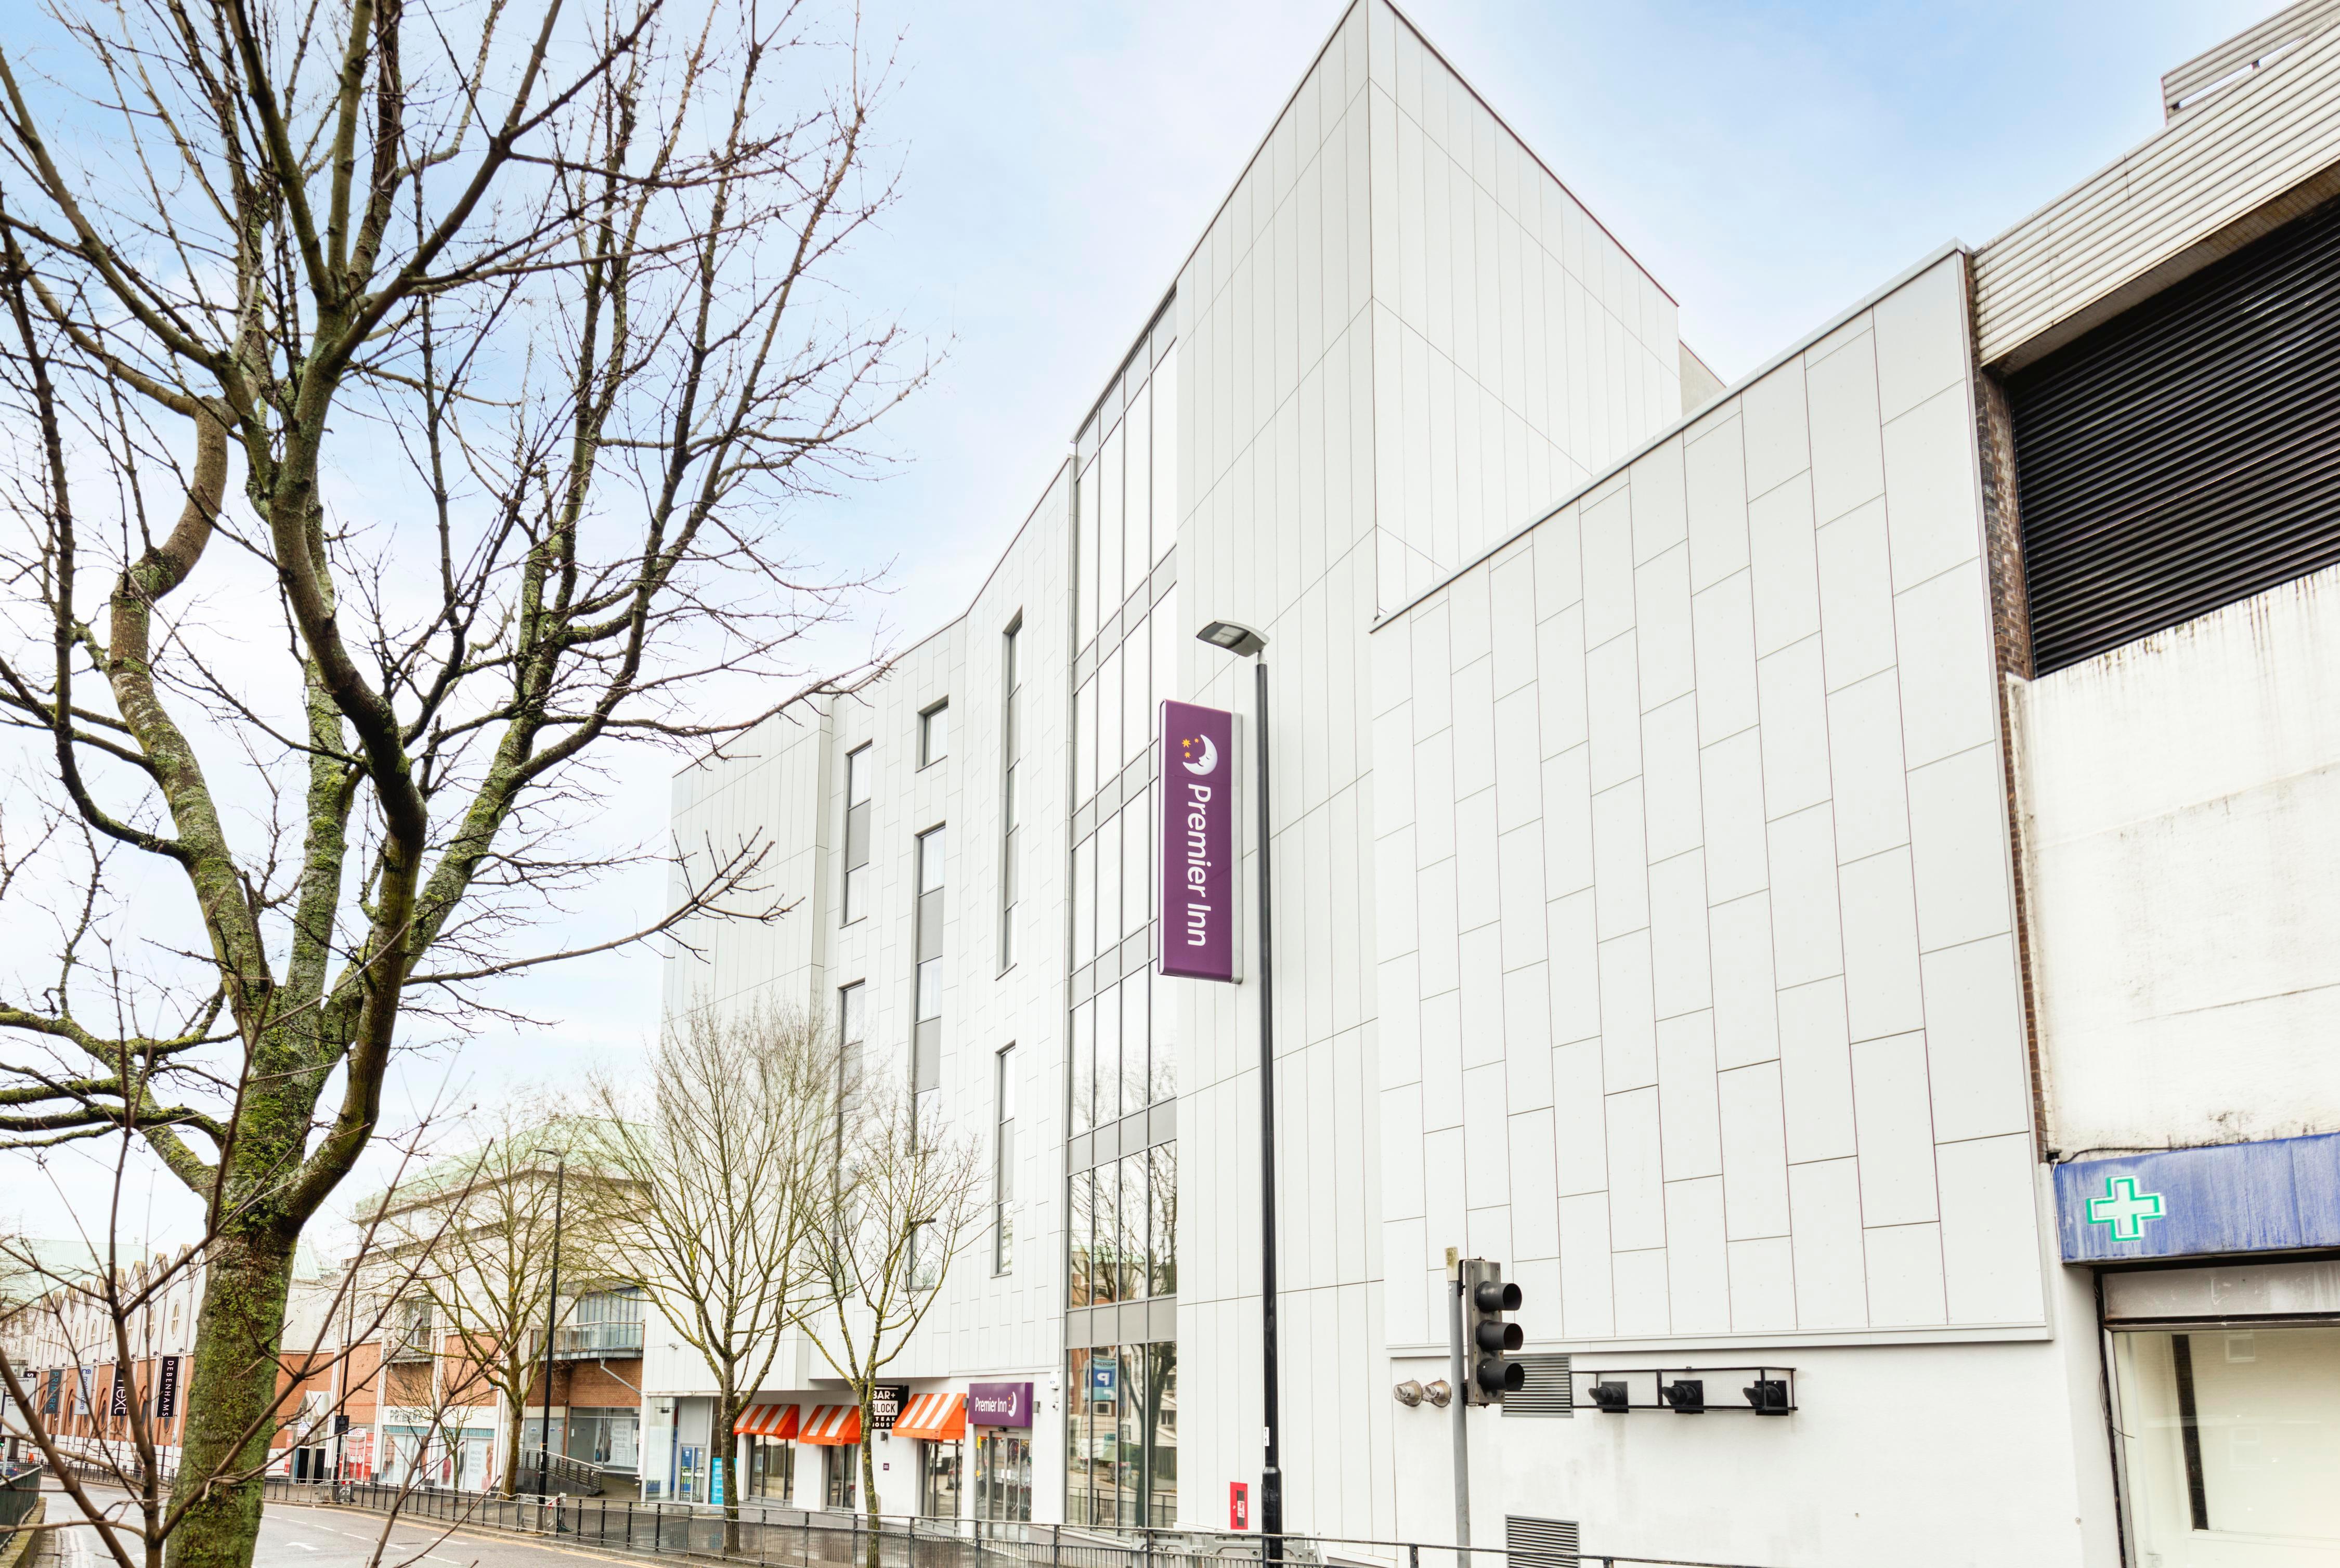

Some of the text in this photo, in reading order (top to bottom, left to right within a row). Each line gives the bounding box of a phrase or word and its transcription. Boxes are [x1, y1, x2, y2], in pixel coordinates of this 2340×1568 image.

[1187, 783, 1212, 947] Premier Inn
[49, 1372, 59, 1410] PRIMARK
[162, 1360, 174, 1417] DEBENHAMS
[975, 1396, 1007, 1413] Premier Inn
